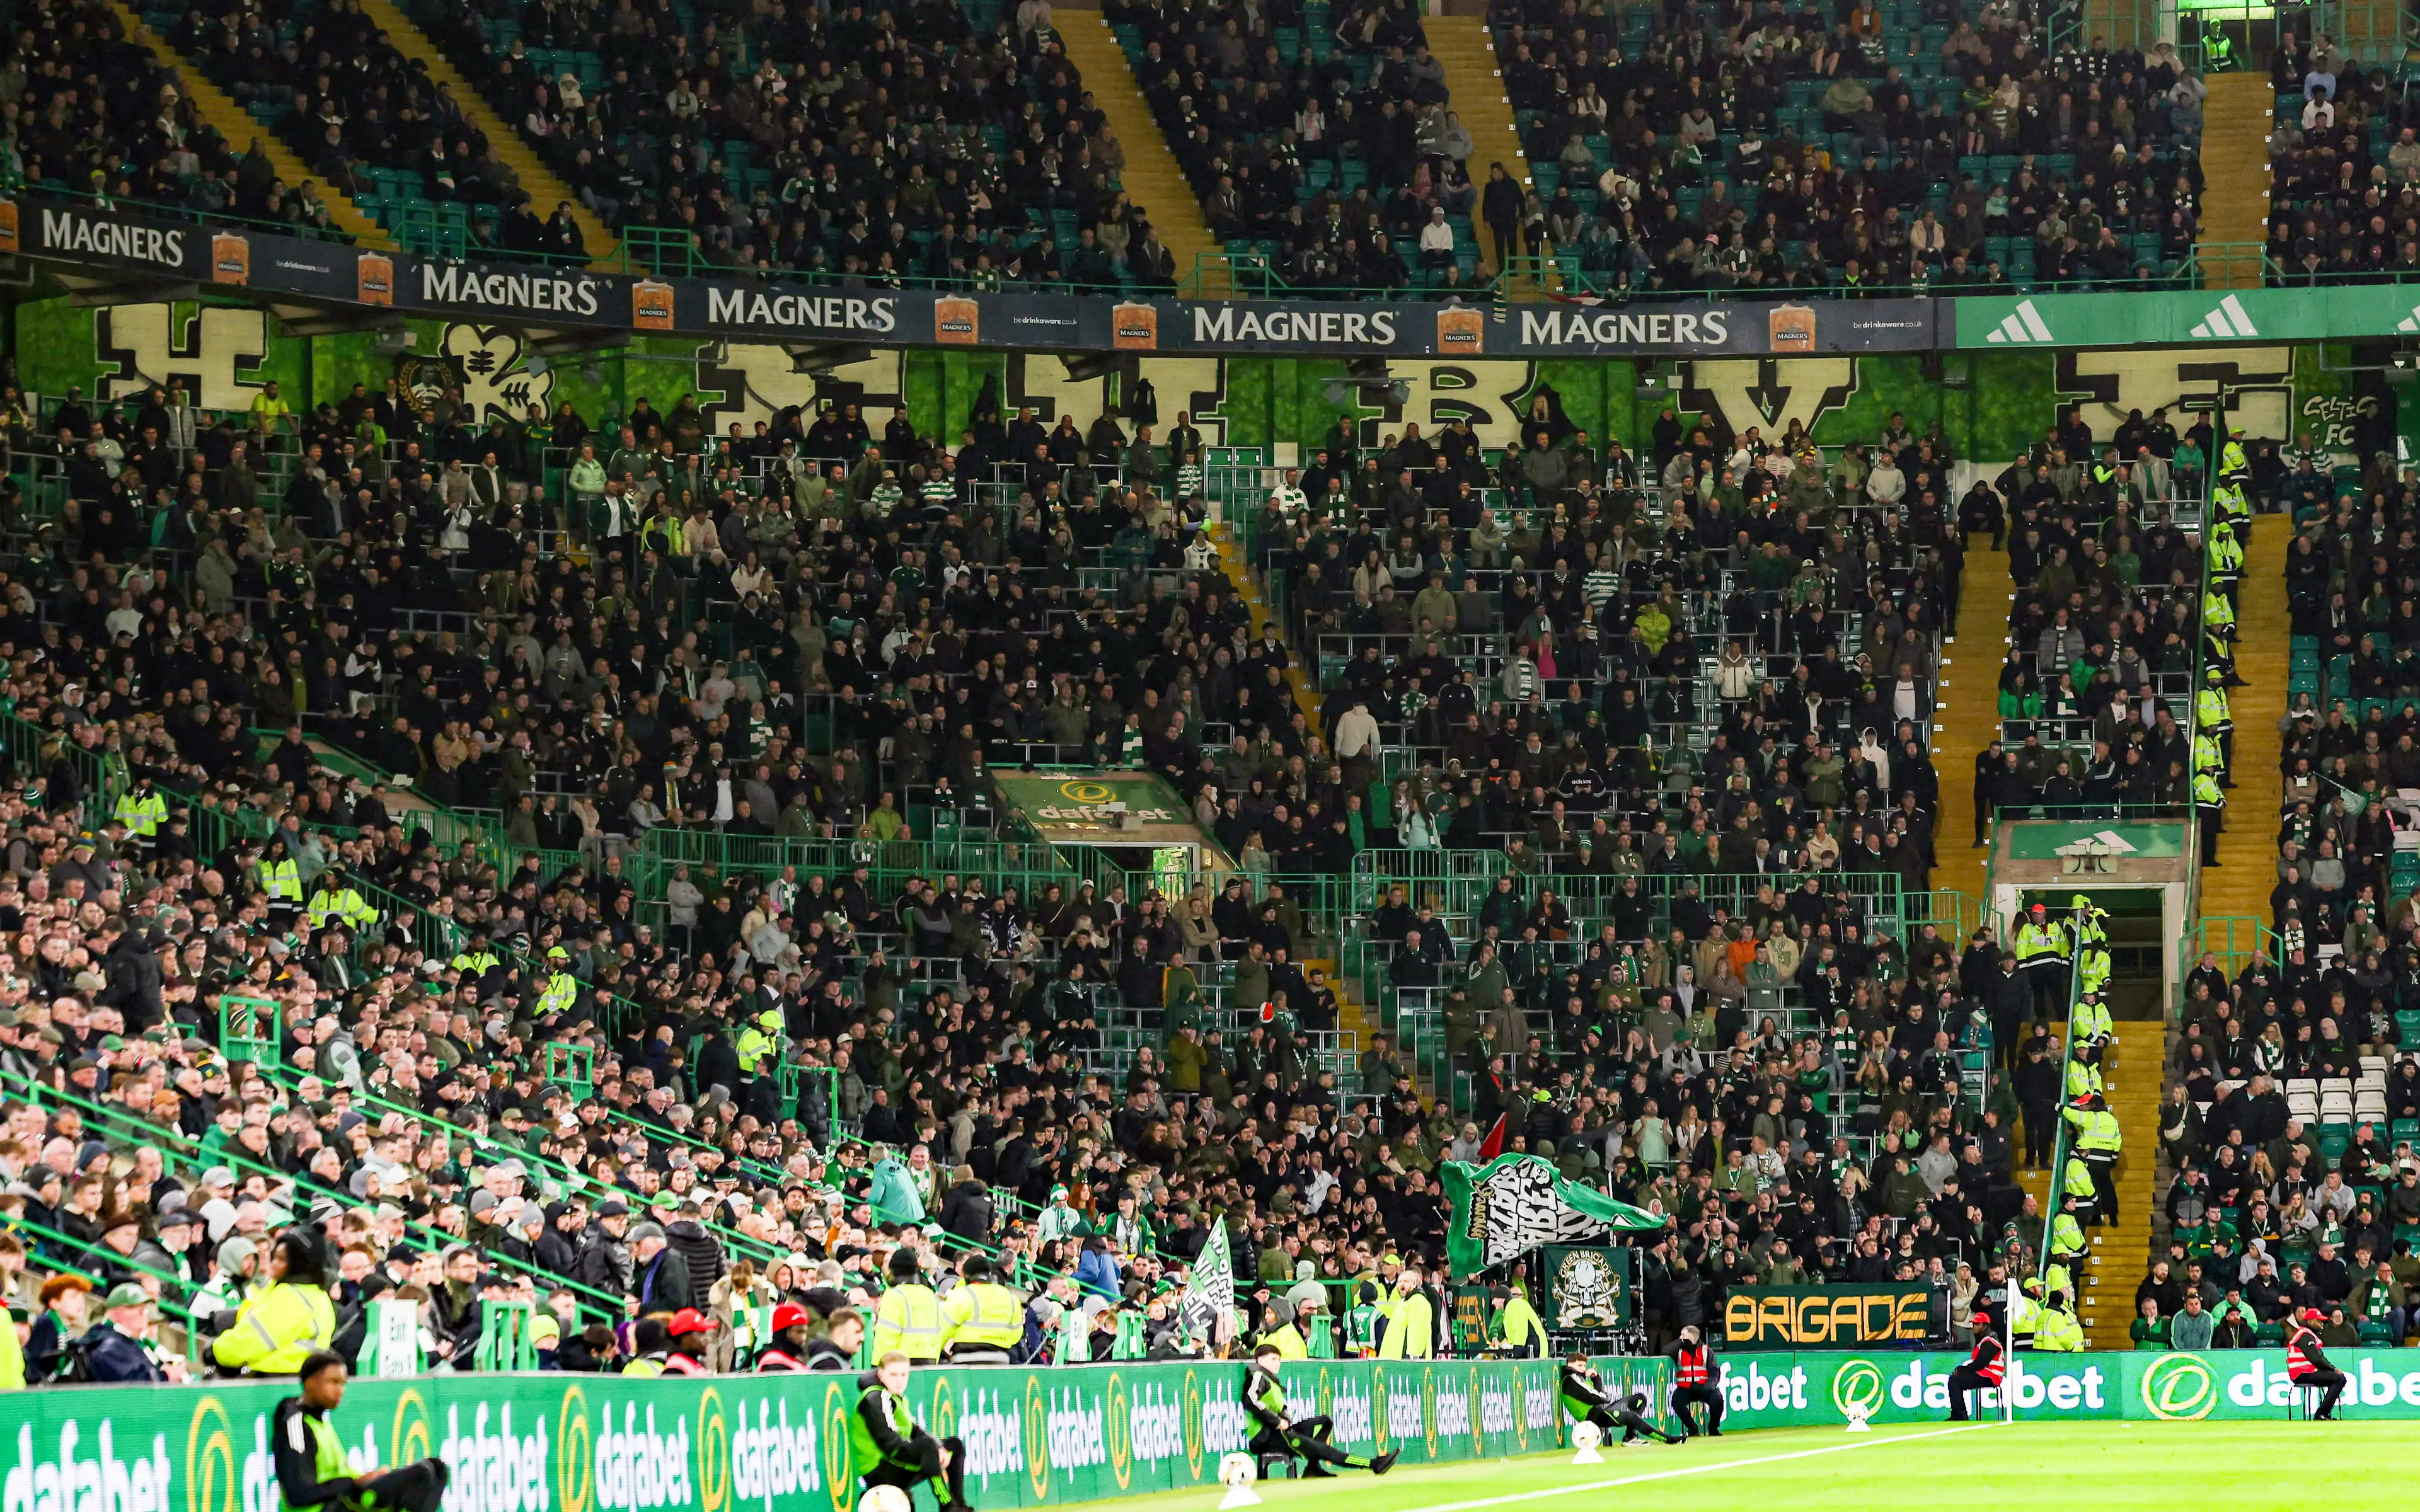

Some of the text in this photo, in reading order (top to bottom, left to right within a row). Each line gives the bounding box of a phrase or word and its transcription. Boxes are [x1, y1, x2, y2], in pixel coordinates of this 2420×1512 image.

[42, 209, 183, 267] MAGNERS
[423, 263, 598, 316] MAGNERS
[639, 307, 667, 318] MAGNERS
[708, 287, 896, 332] MAGNERS
[942, 323, 972, 332] MAGNERS
[1013, 316, 1078, 326] bedrinkaware.co.uk
[1119, 328, 1150, 337] MAGNERS
[1194, 306, 1396, 345] MAGNERS
[1444, 334, 1475, 342] MAGNERS
[1521, 310, 1728, 345] MAGNERS
[1777, 332, 1809, 340] MAGNERS
[1853, 320, 1922, 329] bedrinkaware.co.uk
[2303, 396, 2377, 421] CELTIC
[1560, 1250, 1614, 1278] GREEN BRIGADE
[1726, 1293, 1928, 1343] BRIGADE
[1333, 1376, 1372, 1454] dafabet
[1388, 1375, 1422, 1450] dafabet
[1436, 1375, 1470, 1448] dafabet
[1482, 1375, 1514, 1444] dafabet
[1717, 1361, 1807, 1422] fabet
[1047, 1385, 1105, 1485] dafabet
[1130, 1382, 1183, 1474] dafabet
[1202, 1378, 1250, 1461] dafabe
[595, 1399, 692, 1512] dafabet
[732, 1396, 820, 1511] dafabet
